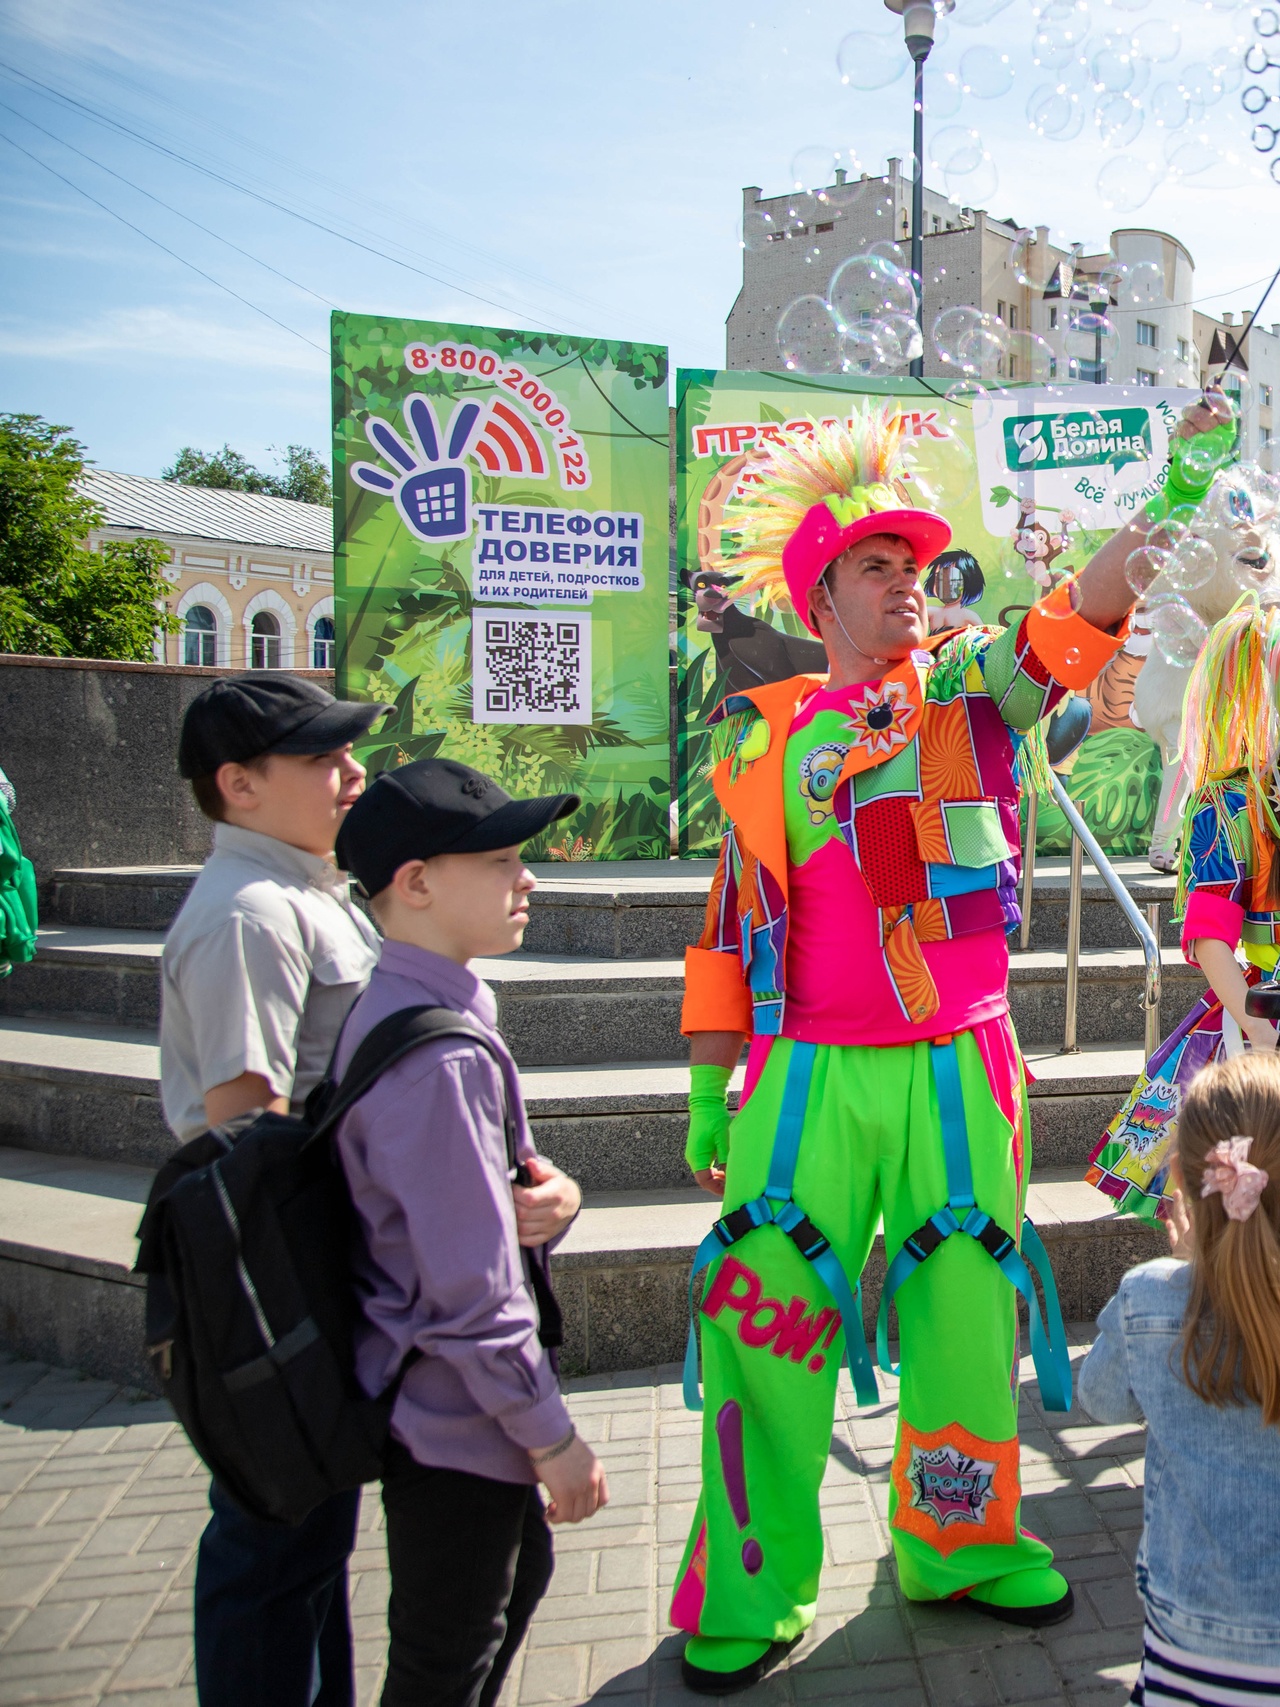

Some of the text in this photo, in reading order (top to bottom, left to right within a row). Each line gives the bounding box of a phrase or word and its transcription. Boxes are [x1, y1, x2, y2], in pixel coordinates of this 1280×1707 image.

[1050, 418, 1123, 439] Белая
[1052, 434, 1146, 461] Долина
[478, 509, 639, 539] ТЕЛЕФОН
[478, 538, 638, 568] ДОВЕРИЯ
[479, 569, 640, 587] ДЛЯ ДЕТЕЙ, ПОДРОСТКОВ
[479, 585, 588, 600] И ИХ РОДИТЕЛЕЙ
[920, 1472, 992, 1507] POP!
